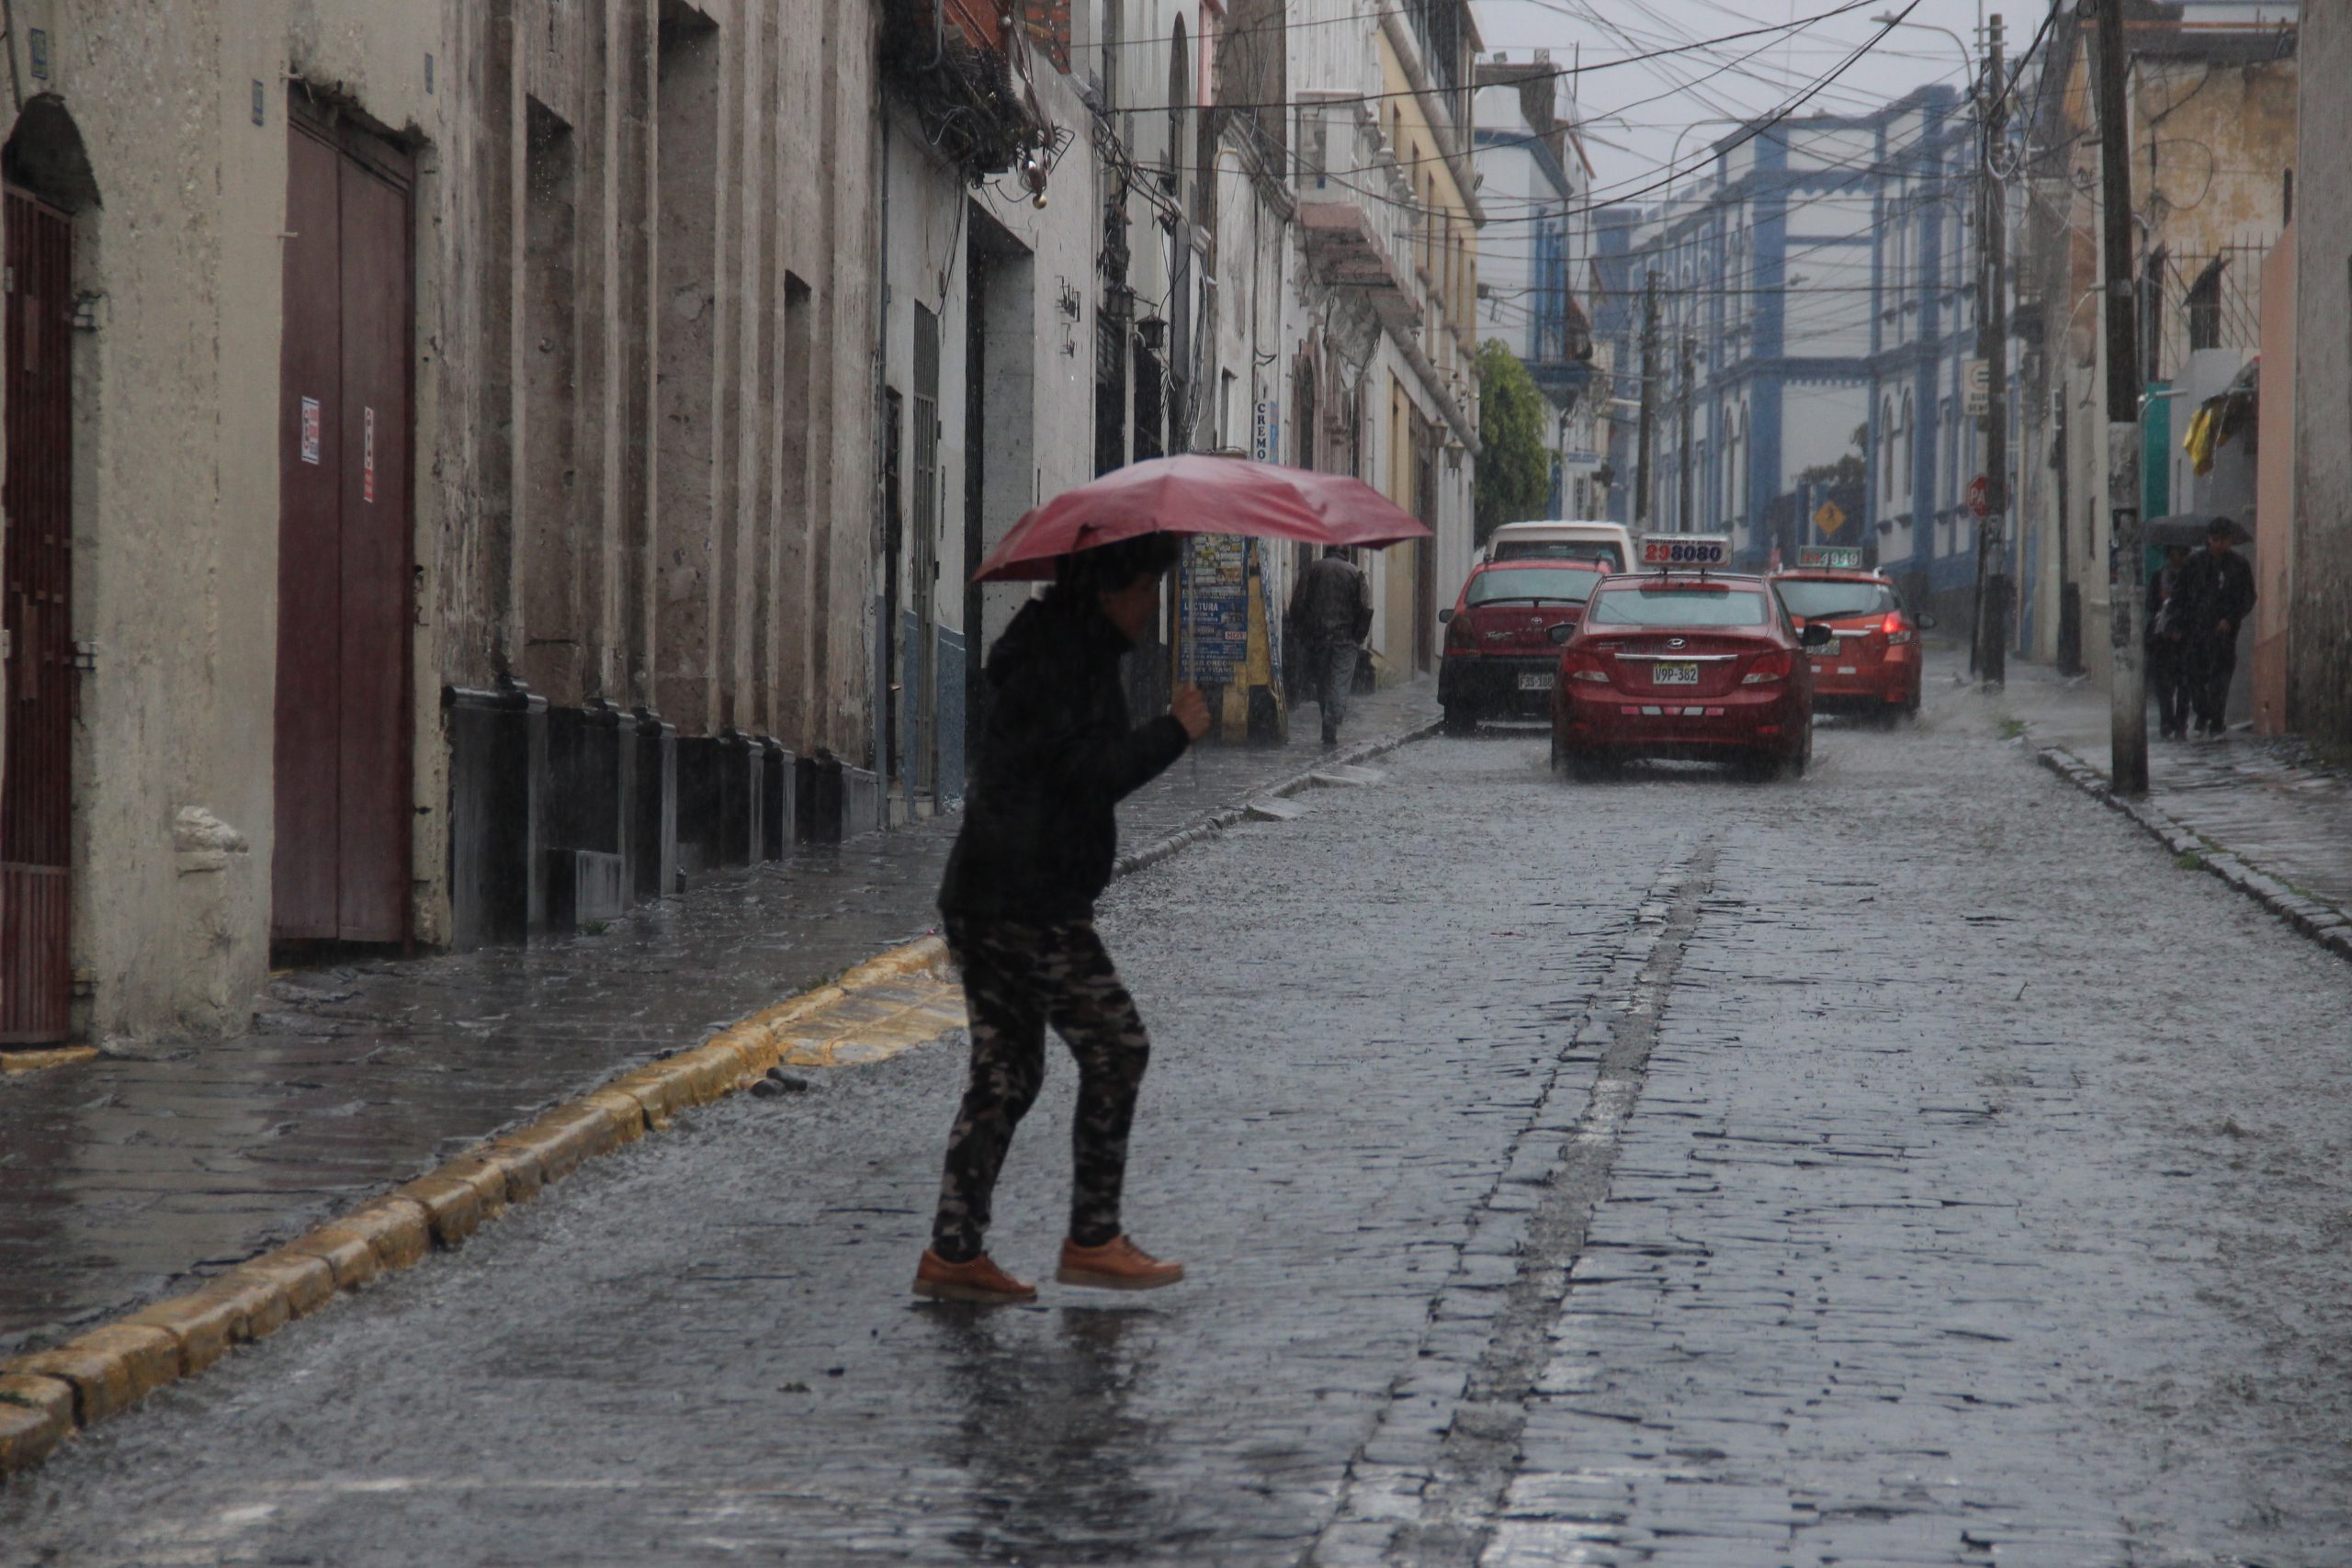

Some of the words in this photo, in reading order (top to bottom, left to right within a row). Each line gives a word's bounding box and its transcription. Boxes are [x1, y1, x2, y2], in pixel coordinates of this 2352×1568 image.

[1257, 403, 1266, 460] CREMO
[1184, 602, 1219, 612] LCTURA
[1655, 668, 1697, 682] V9P-382
